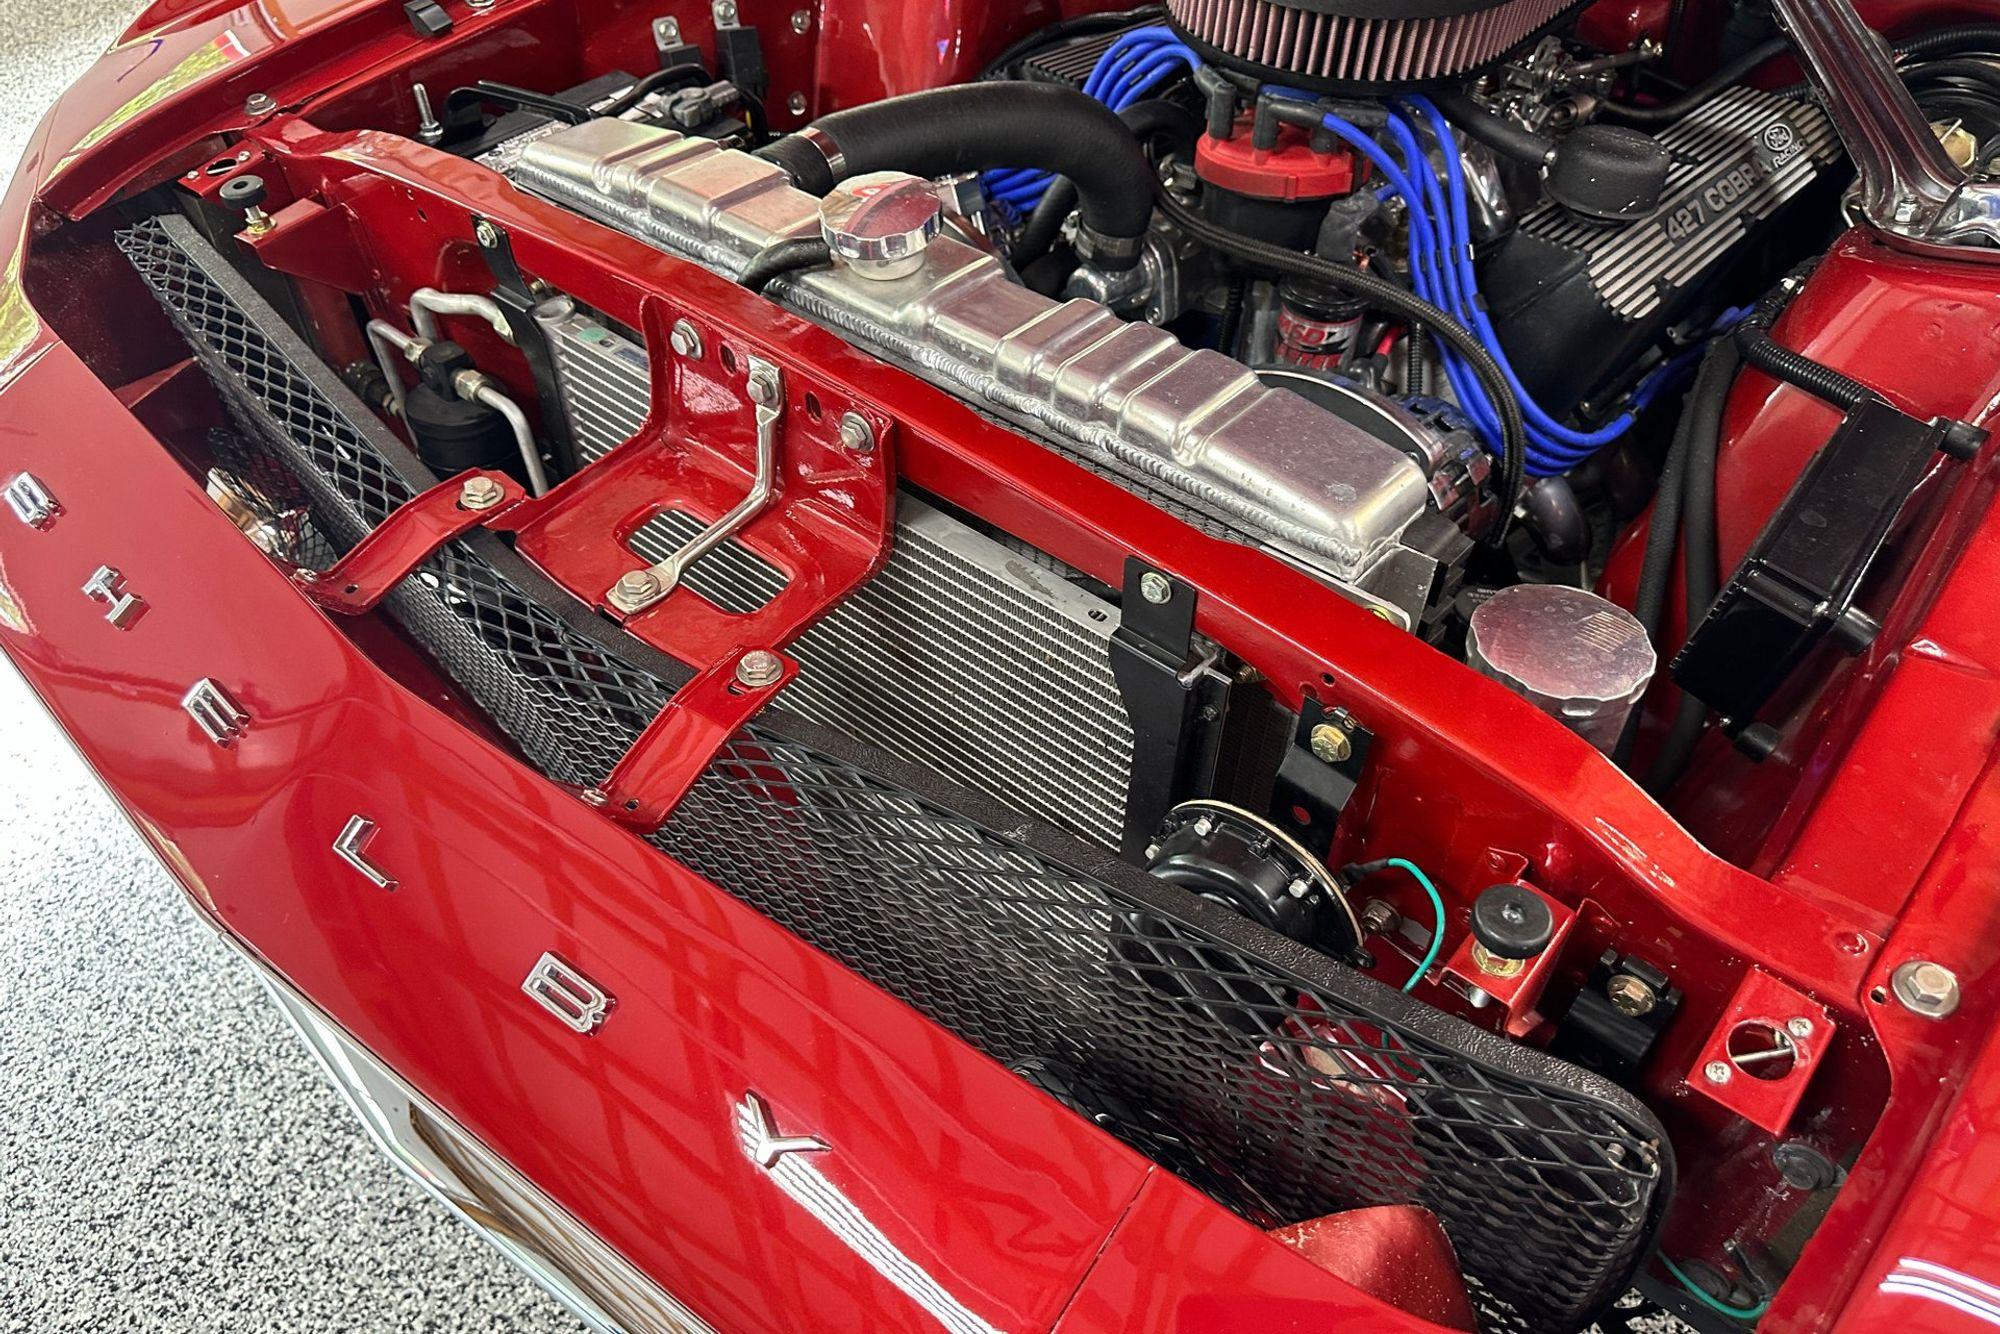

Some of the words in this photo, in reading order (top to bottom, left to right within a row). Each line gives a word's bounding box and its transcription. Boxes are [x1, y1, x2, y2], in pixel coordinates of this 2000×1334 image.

[1772, 138, 1806, 168] RACING
[1667, 199, 1705, 239] 427
[1704, 155, 1772, 211] COBRA
[4, 470, 833, 1169] SHELBY
